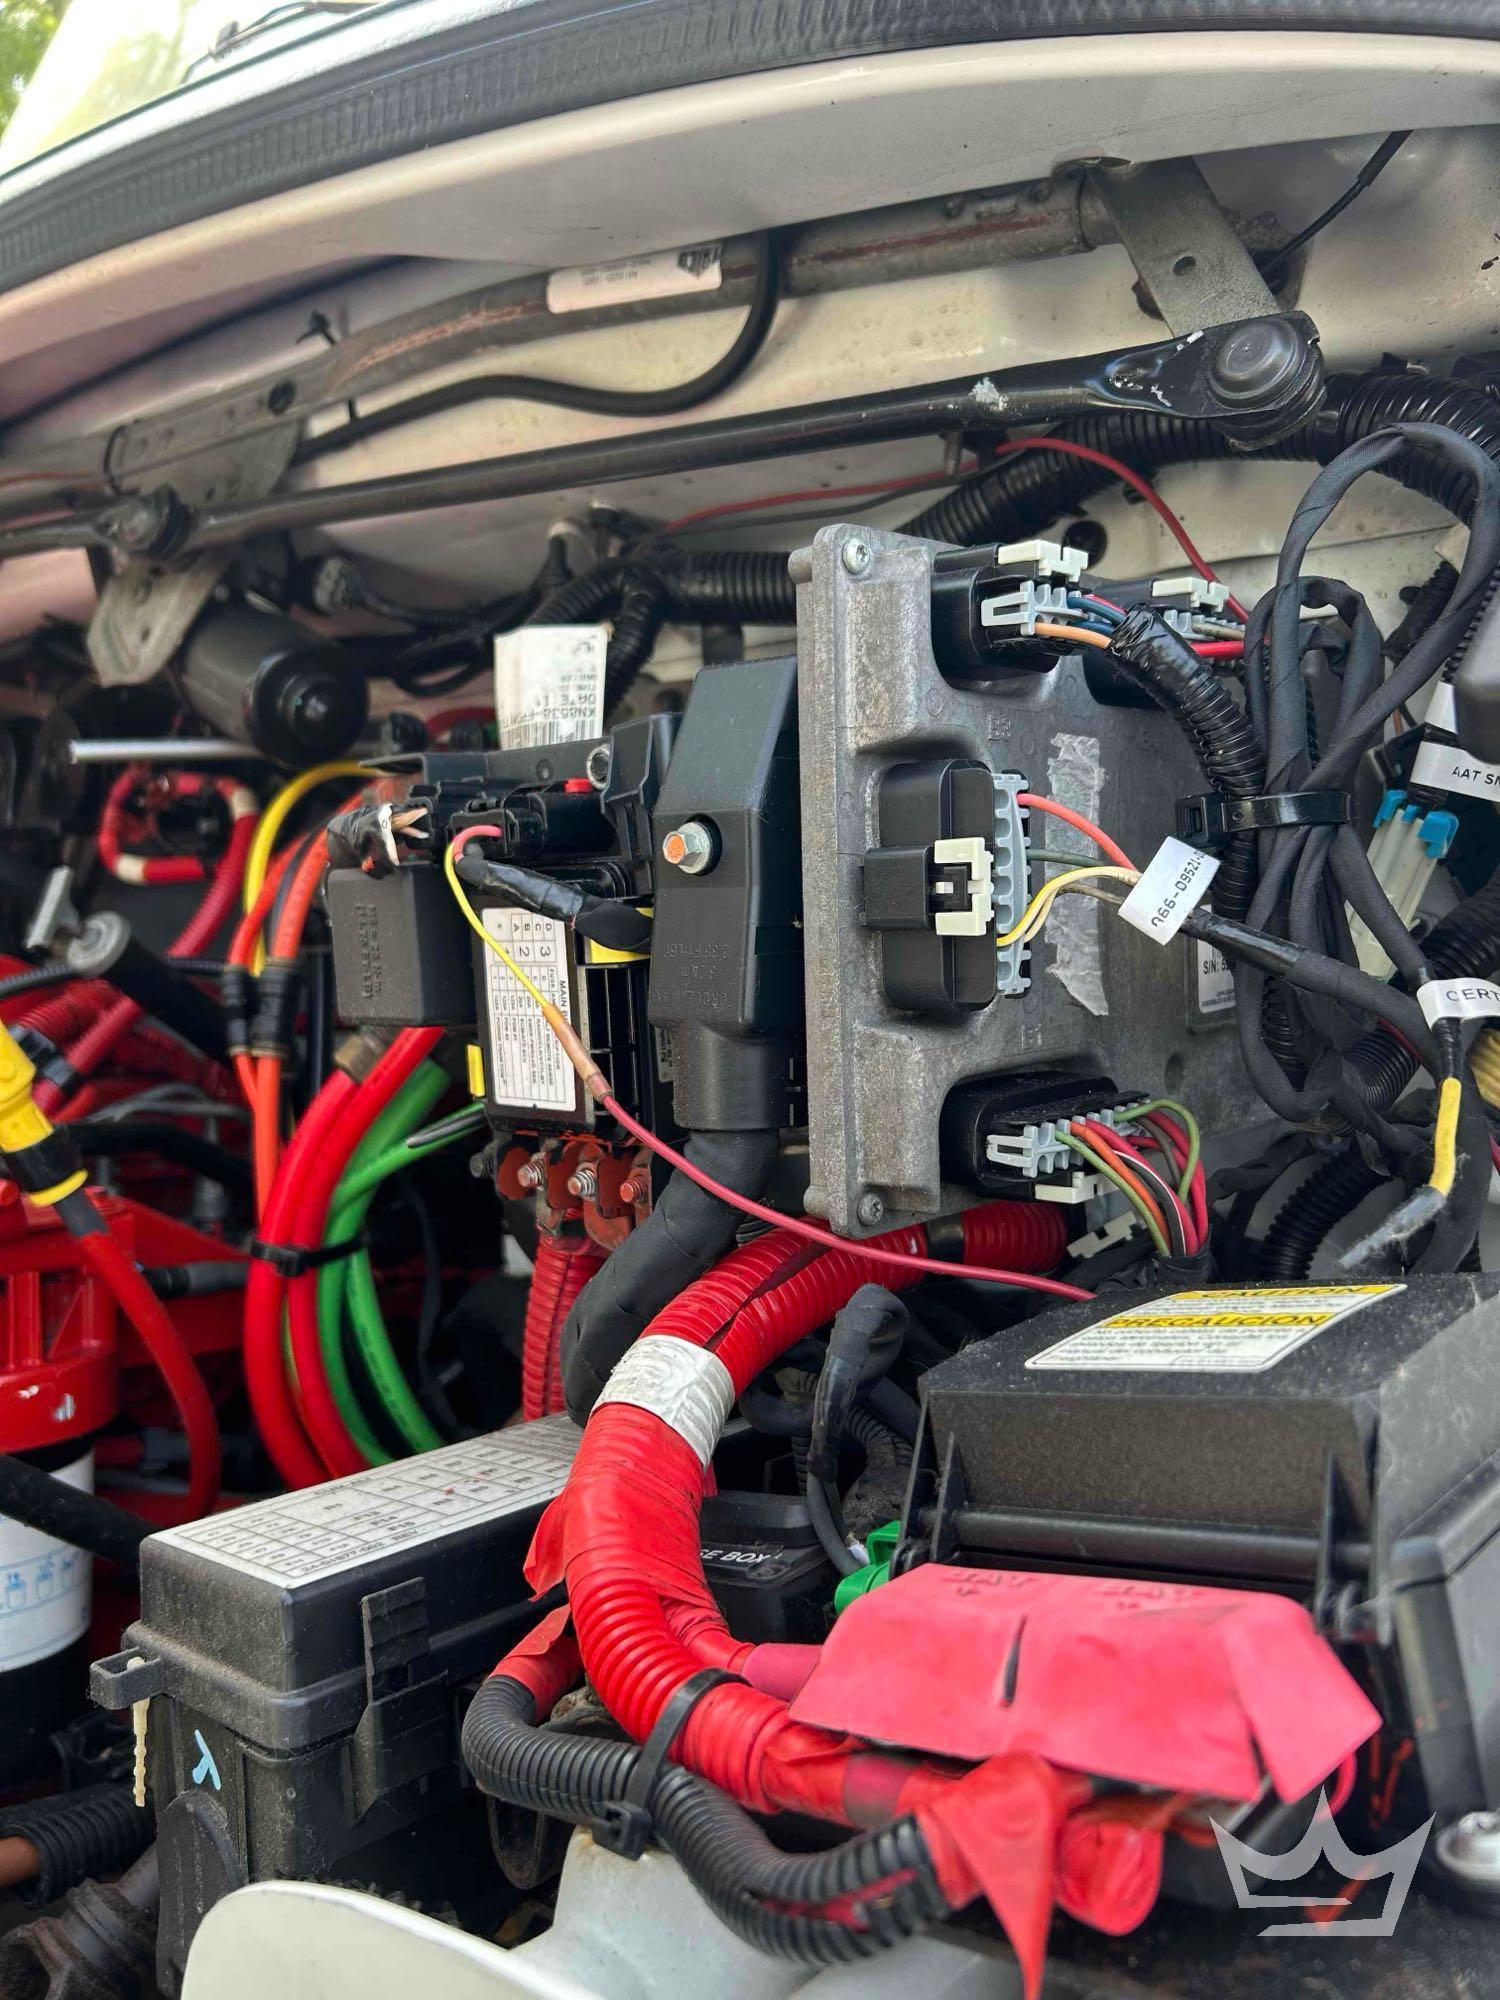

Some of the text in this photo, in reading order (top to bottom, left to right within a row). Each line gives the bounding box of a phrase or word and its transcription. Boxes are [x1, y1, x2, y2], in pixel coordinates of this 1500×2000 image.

[1452, 766, 1482, 781] AAT
[513, 923, 520, 932] A
[524, 923, 531, 931] B
[535, 923, 541, 931] C
[519, 946, 530, 957] 2
[540, 946, 551, 957] 3
[558, 980, 568, 1007] MAIN
[1201, 1286, 1364, 1298] CAUTION
[1106, 1315, 1326, 1328] PRECAUCION
